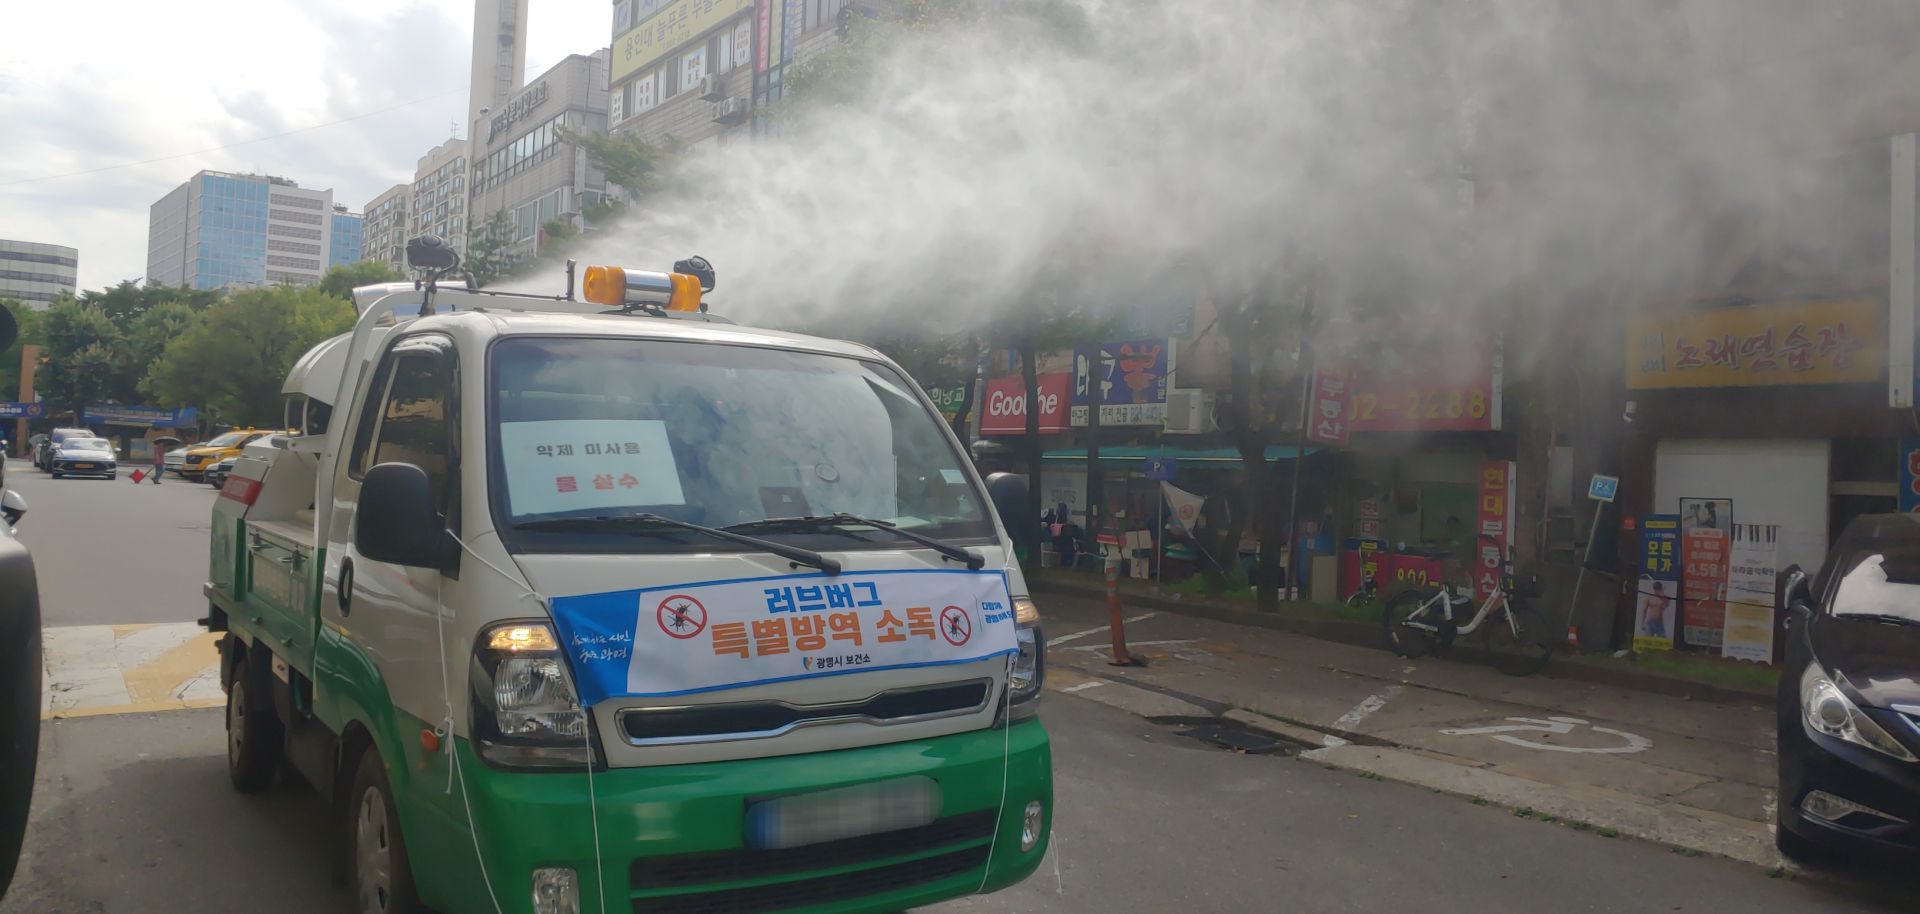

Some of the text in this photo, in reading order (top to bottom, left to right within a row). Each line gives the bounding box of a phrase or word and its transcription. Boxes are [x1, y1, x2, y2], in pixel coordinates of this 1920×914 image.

[536, 442, 640, 457] 약제 미사용
[556, 473, 639, 493] 물 살수
[763, 581, 883, 614] 러브버그
[711, 606, 937, 659] 특별방역 소독
[816, 653, 871, 669] 광명시 보건소
